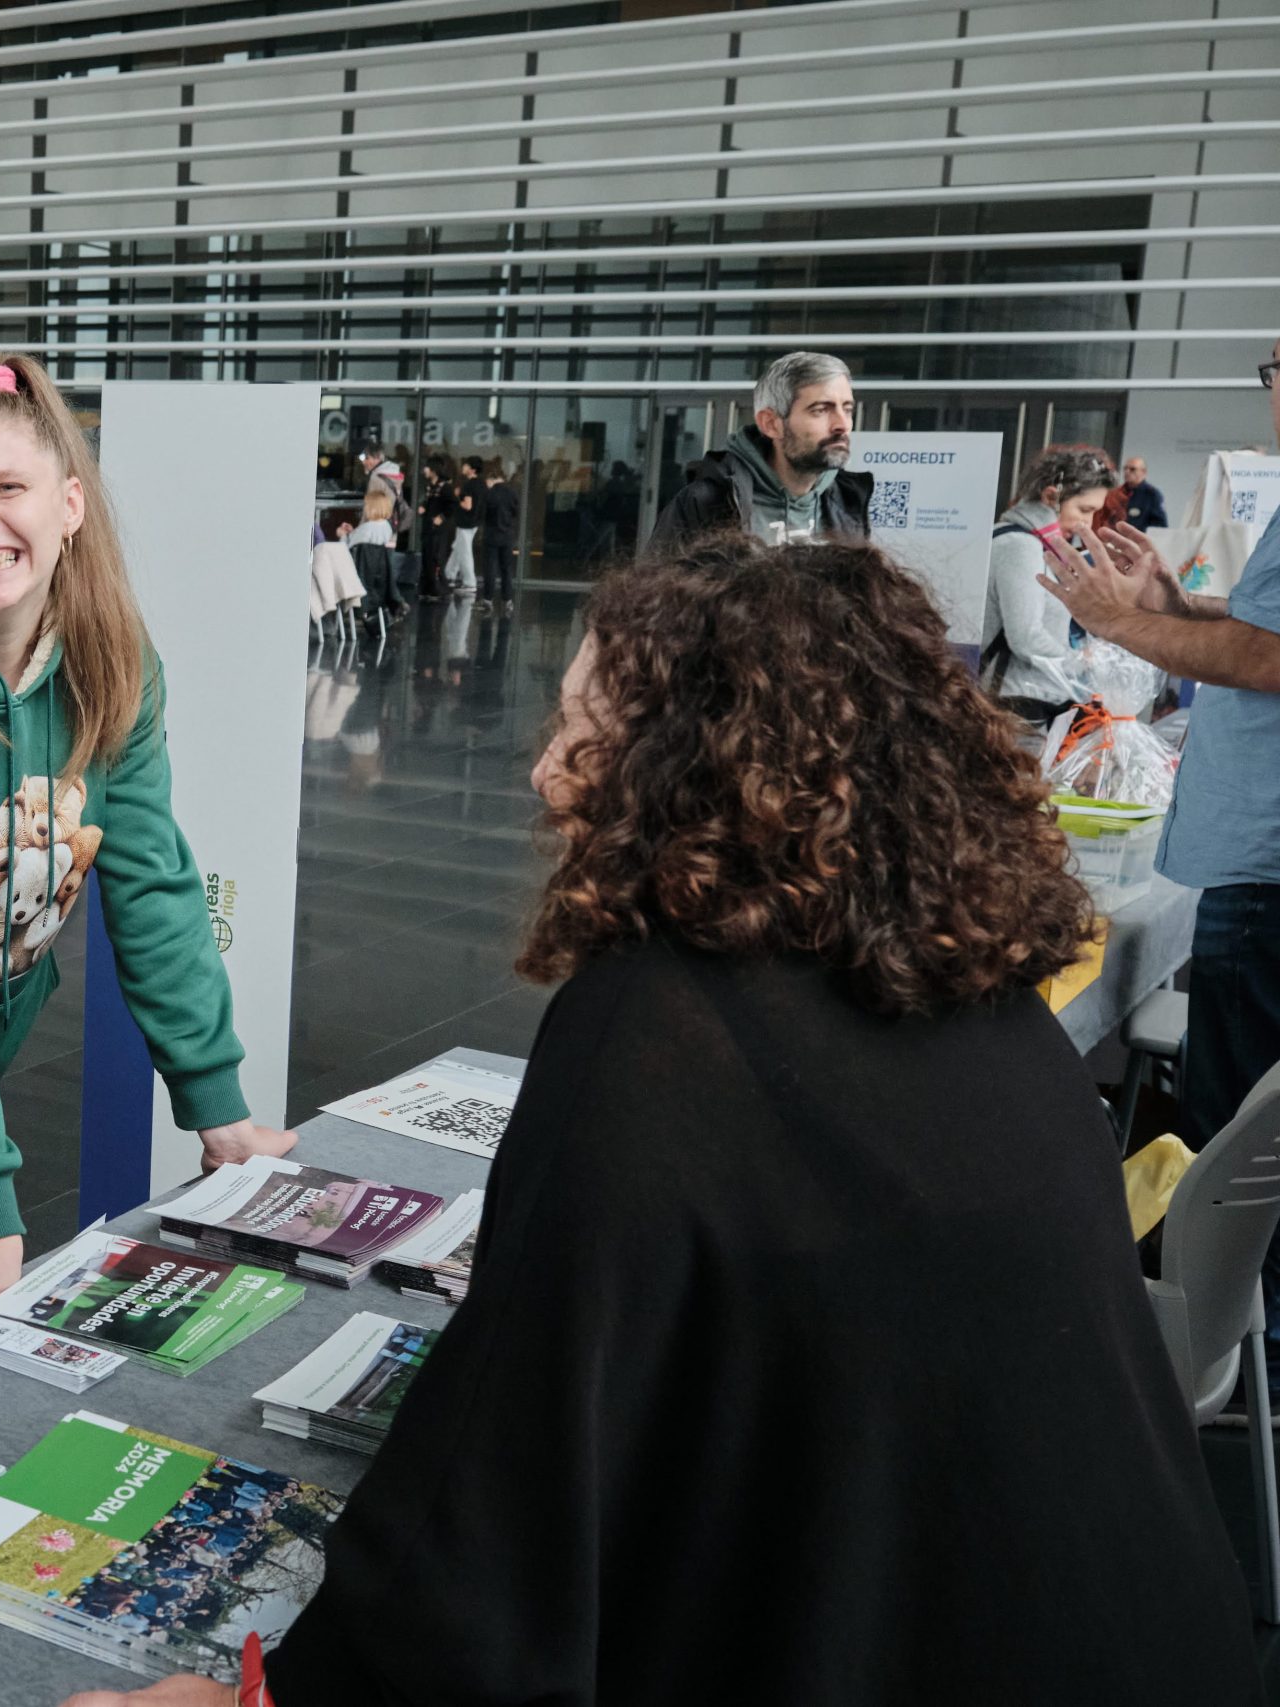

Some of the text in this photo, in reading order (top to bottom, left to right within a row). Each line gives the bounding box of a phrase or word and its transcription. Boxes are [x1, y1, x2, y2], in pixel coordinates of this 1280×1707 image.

[323, 411, 495, 446] Cmara
[863, 451, 957, 465] OIKOCREDIT
[207, 873, 219, 913] reas
[220, 880, 238, 916] rioja
[347, 1207, 378, 1230] pioneros
[74, 1260, 180, 1333] oportunidades
[125, 1265, 206, 1317] Invierte en
[155, 1270, 221, 1318] #EmpresasPioneras
[112, 1440, 149, 1475] 2024
[85, 1445, 171, 1523] MEMORIA
